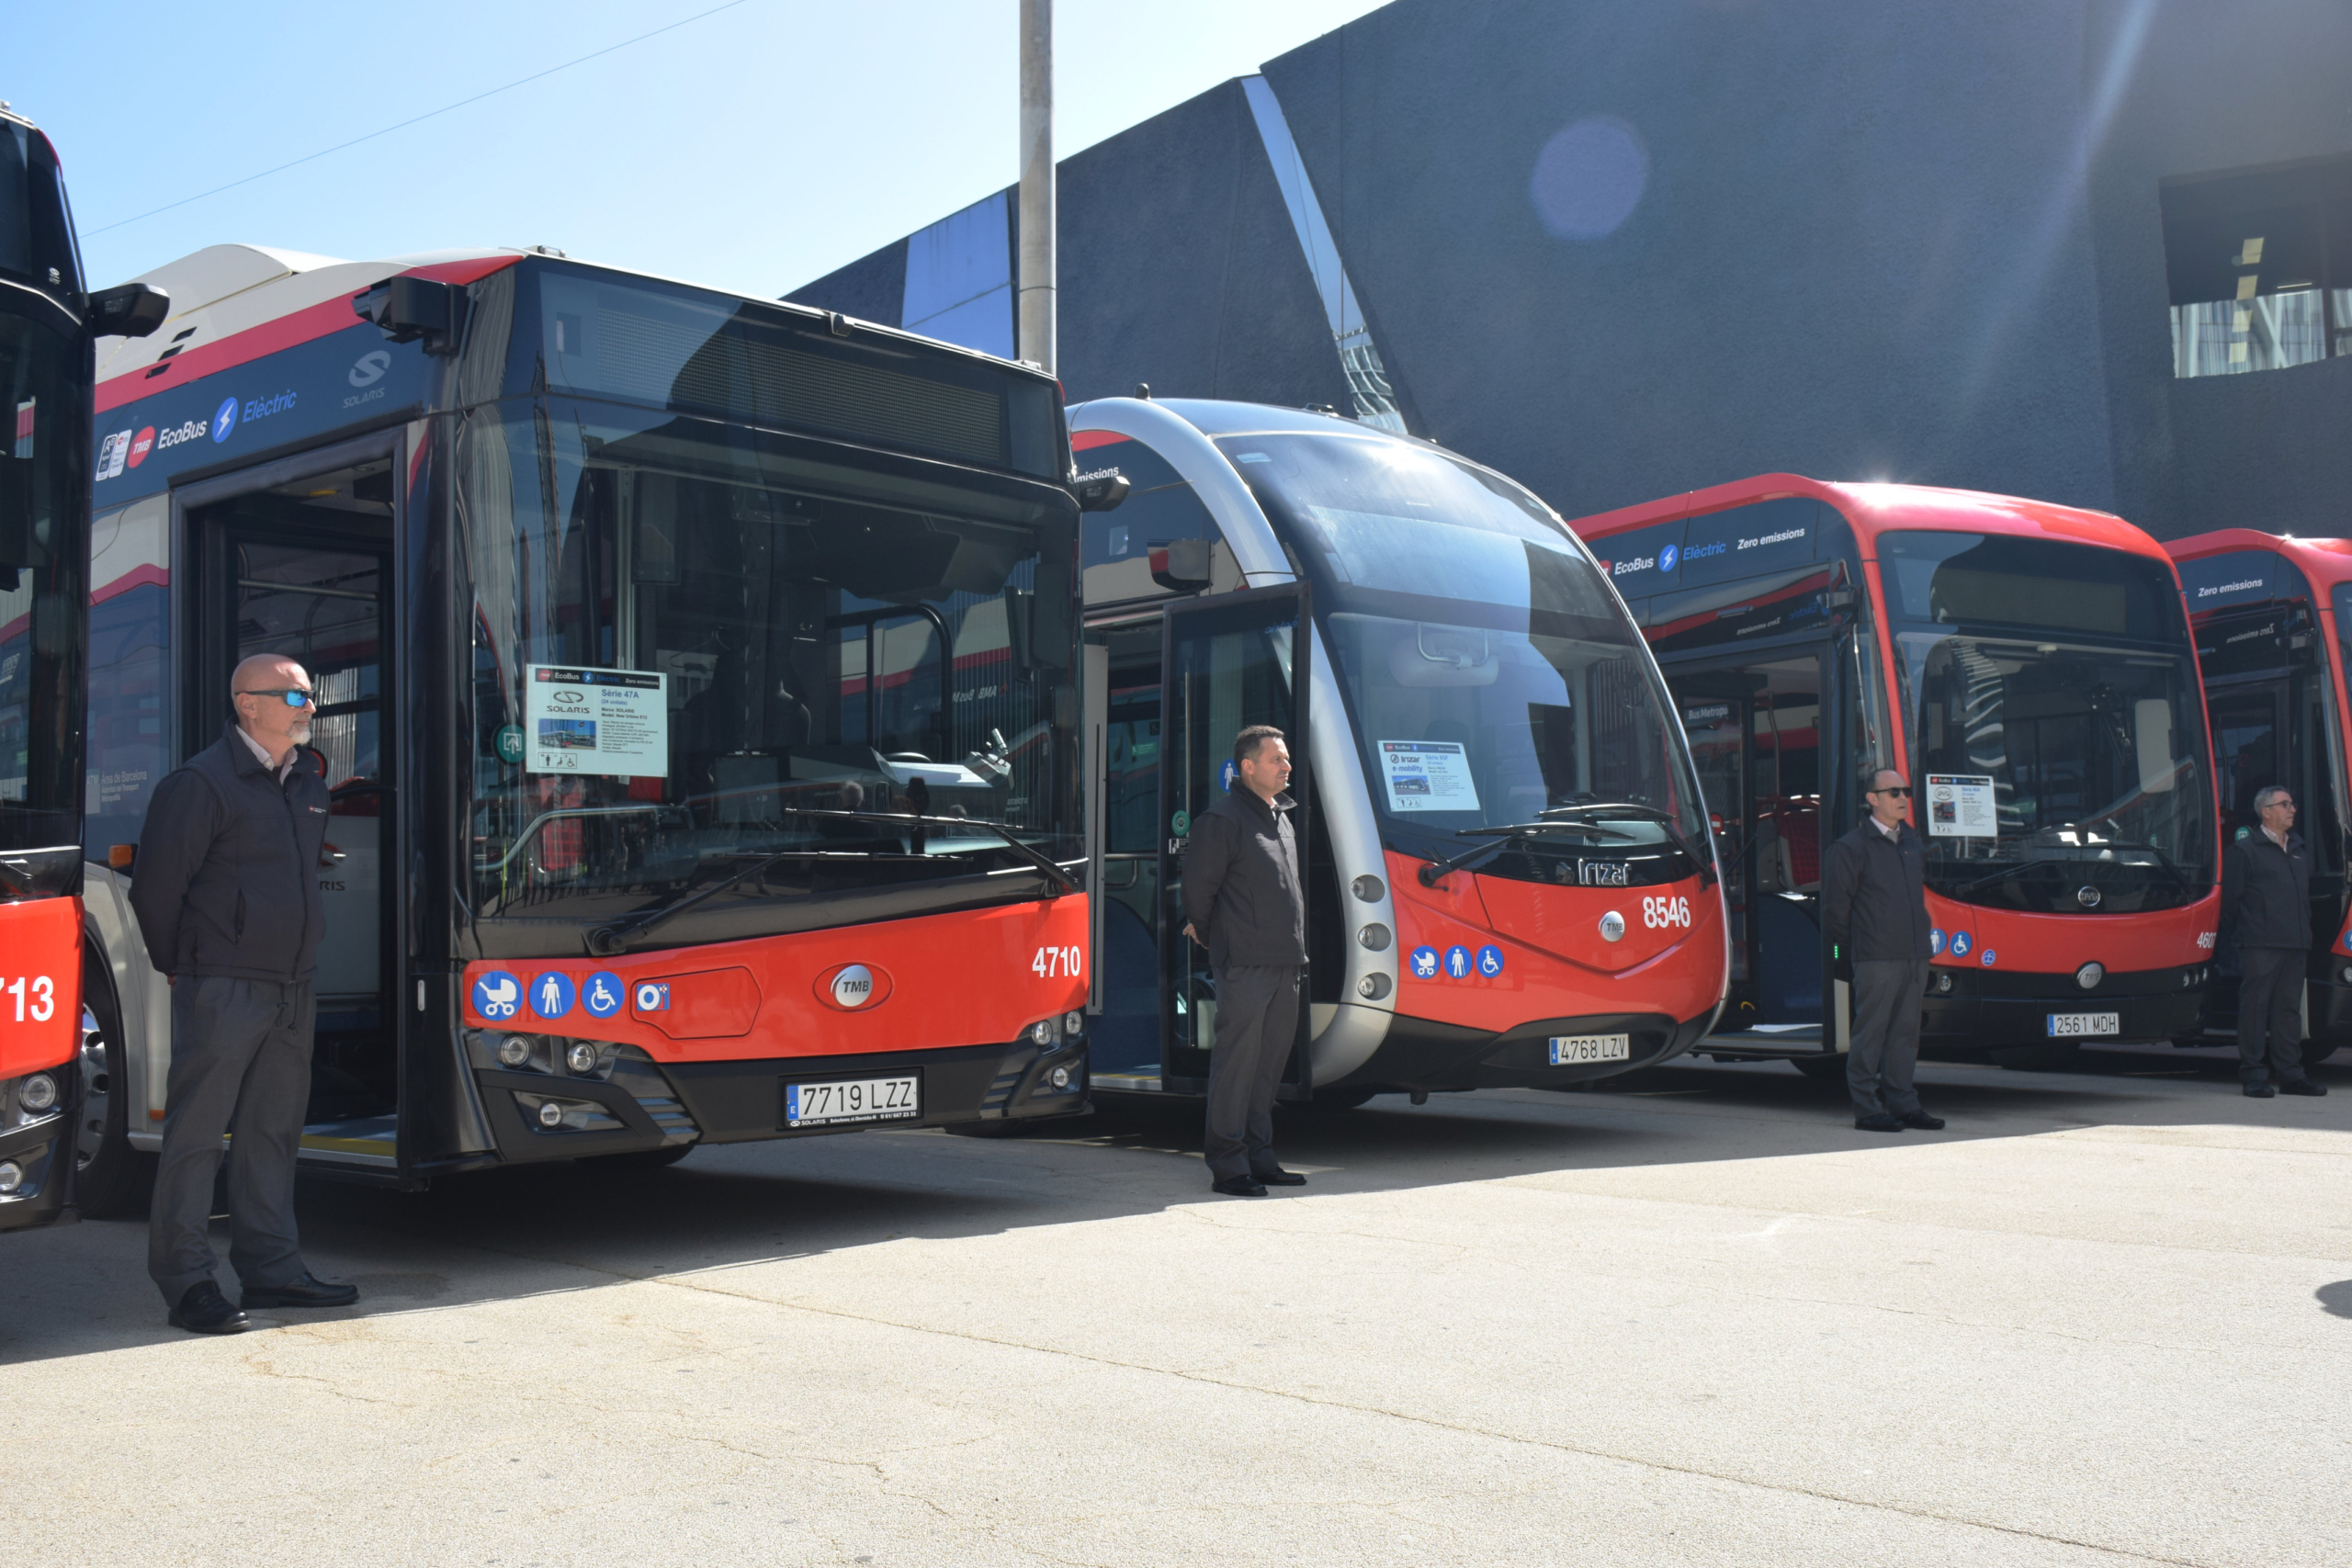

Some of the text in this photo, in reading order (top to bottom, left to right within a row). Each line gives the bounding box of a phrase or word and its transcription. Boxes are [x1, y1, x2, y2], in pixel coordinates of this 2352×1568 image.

[343, 388, 385, 409] SOLARIS
[133, 389, 297, 455] TMB EcoBus Elèctric
[1077, 467, 1119, 482] missions
[1614, 557, 1654, 575] EcoBus
[1682, 542, 1726, 560] Elèctric
[1737, 536, 1758, 549] Zero
[1759, 527, 1805, 545] emissions
[2198, 579, 2263, 597] Zero emissions
[554, 672, 580, 681] EcoBus
[624, 690, 639, 699] 47A
[547, 705, 591, 714] SOLARIS
[1689, 709, 1700, 719] Bus
[1578, 858, 1632, 886] Irizar
[1642, 896, 1690, 929] 8546
[1606, 922, 1623, 931] TMB
[1032, 945, 1081, 978] 4710
[842, 980, 870, 994] TMB
[2057, 1015, 2116, 1033] 2561 MDH
[1561, 1039, 1598, 1061] 4768
[1602, 1037, 1625, 1057] LZV
[804, 1085, 862, 1115] 7719
[872, 1081, 912, 1110] LZZ
